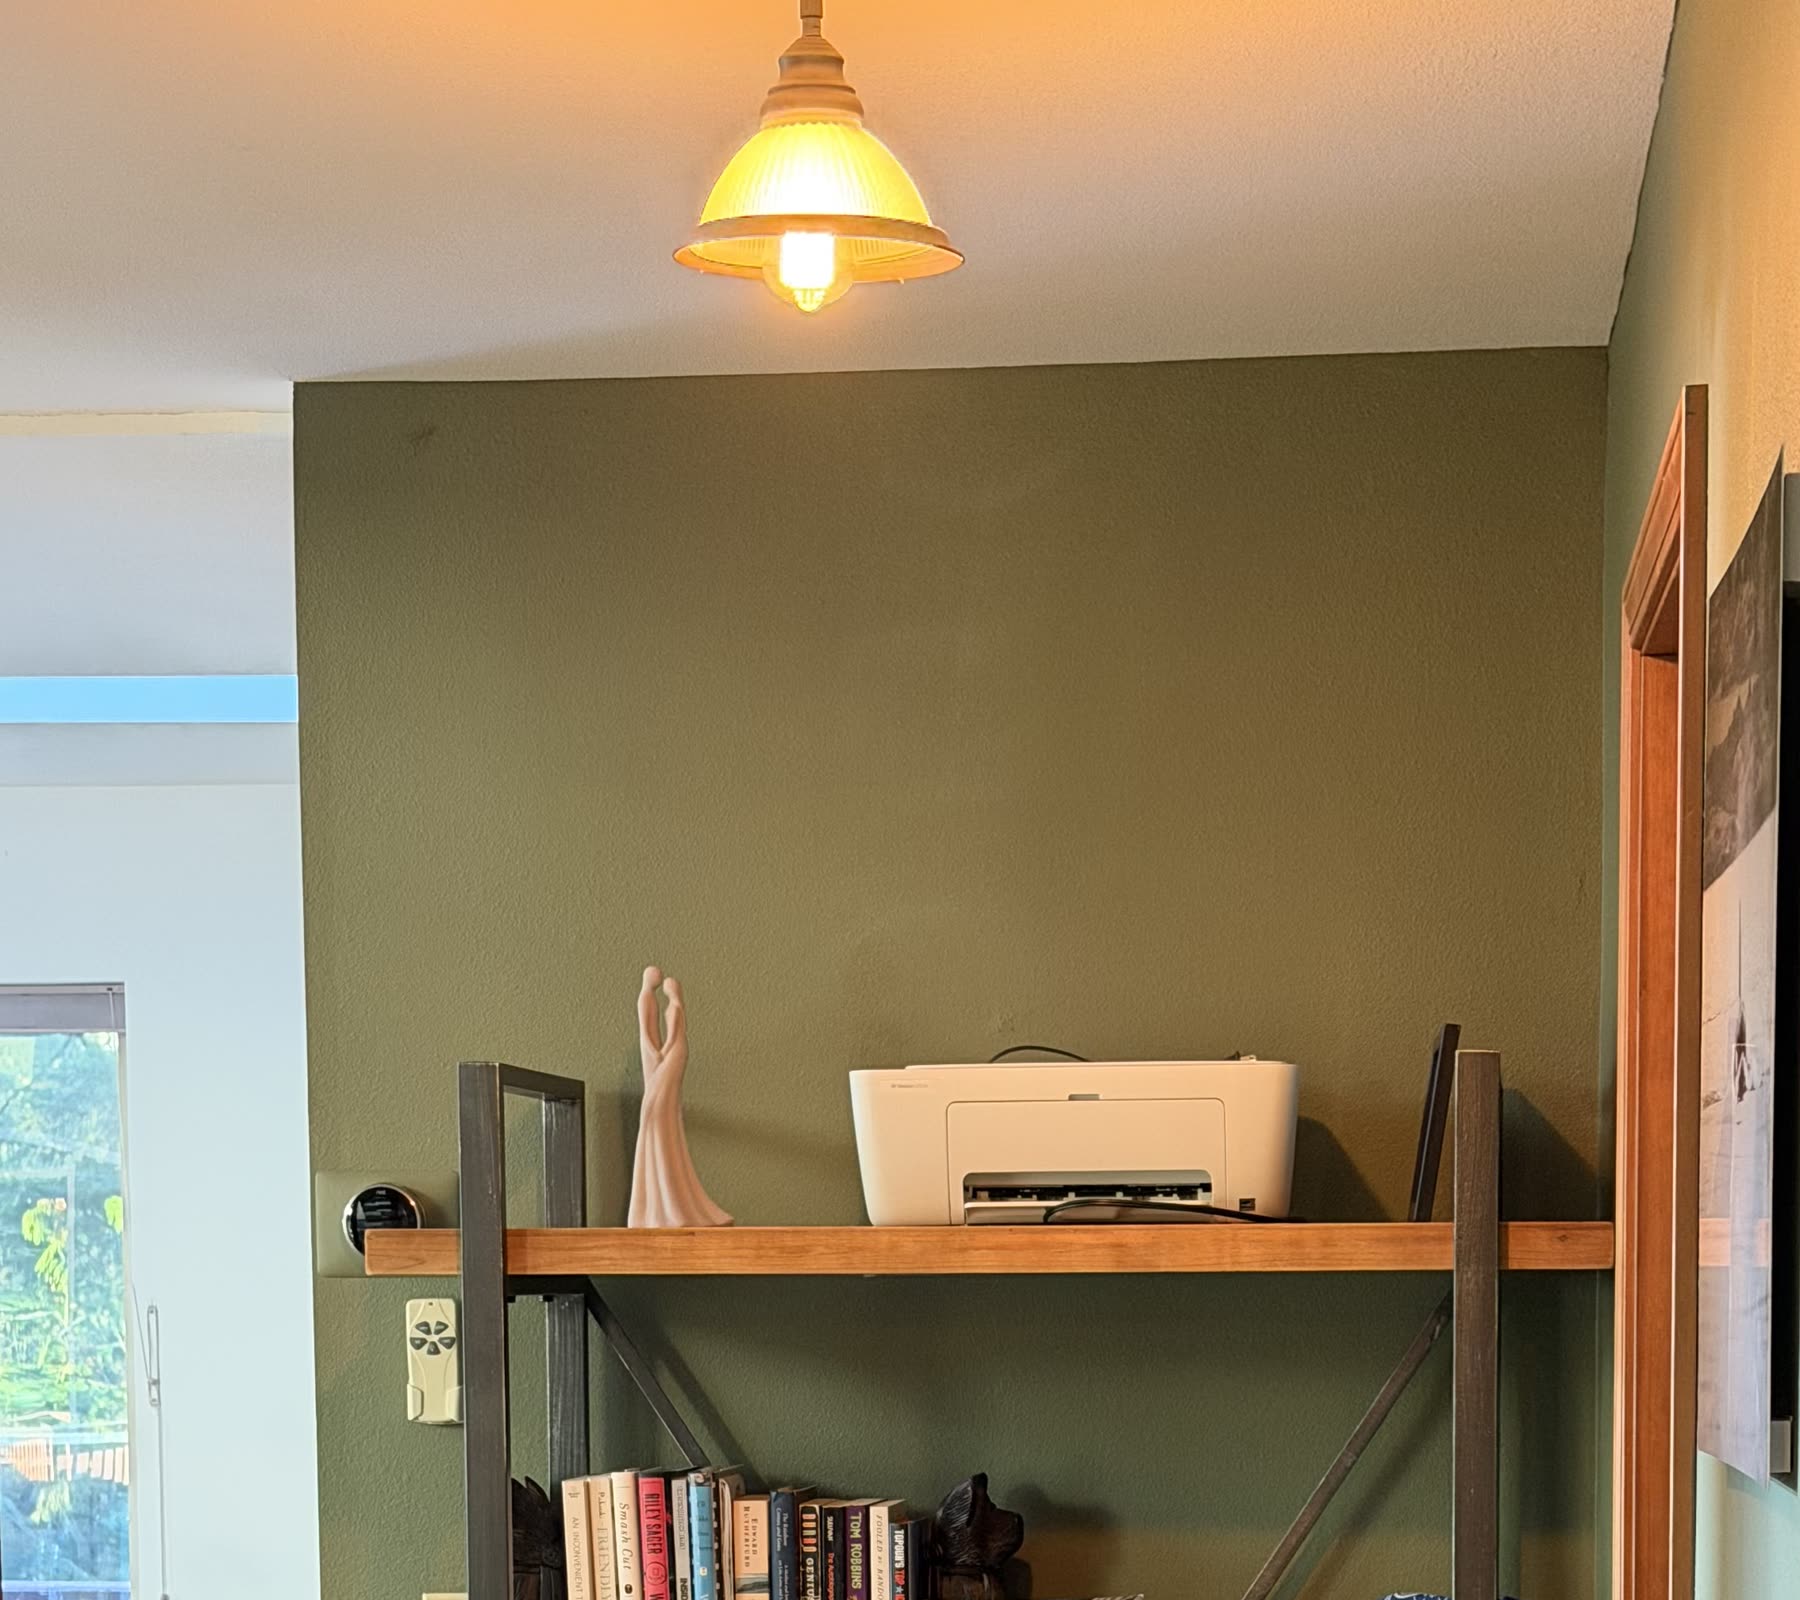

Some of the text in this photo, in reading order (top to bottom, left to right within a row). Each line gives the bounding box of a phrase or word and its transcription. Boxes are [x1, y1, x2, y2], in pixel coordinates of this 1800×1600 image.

[572, 1516, 580, 1529] AN
[619, 1502, 633, 1571] Smash Cut
[644, 1493, 663, 1555] RILEY SAGER
[743, 1505, 751, 1568] RUTHERFURD
[751, 1518, 759, 1555] EDWARD
[876, 1514, 884, 1552] FOOLED
[572, 1530, 583, 1593] INCONVENIENT
[849, 1512, 863, 1589] TOM ROBBINS
[894, 1529, 905, 1568] TOPGUN'S
[895, 1569, 906, 1584] TOP
